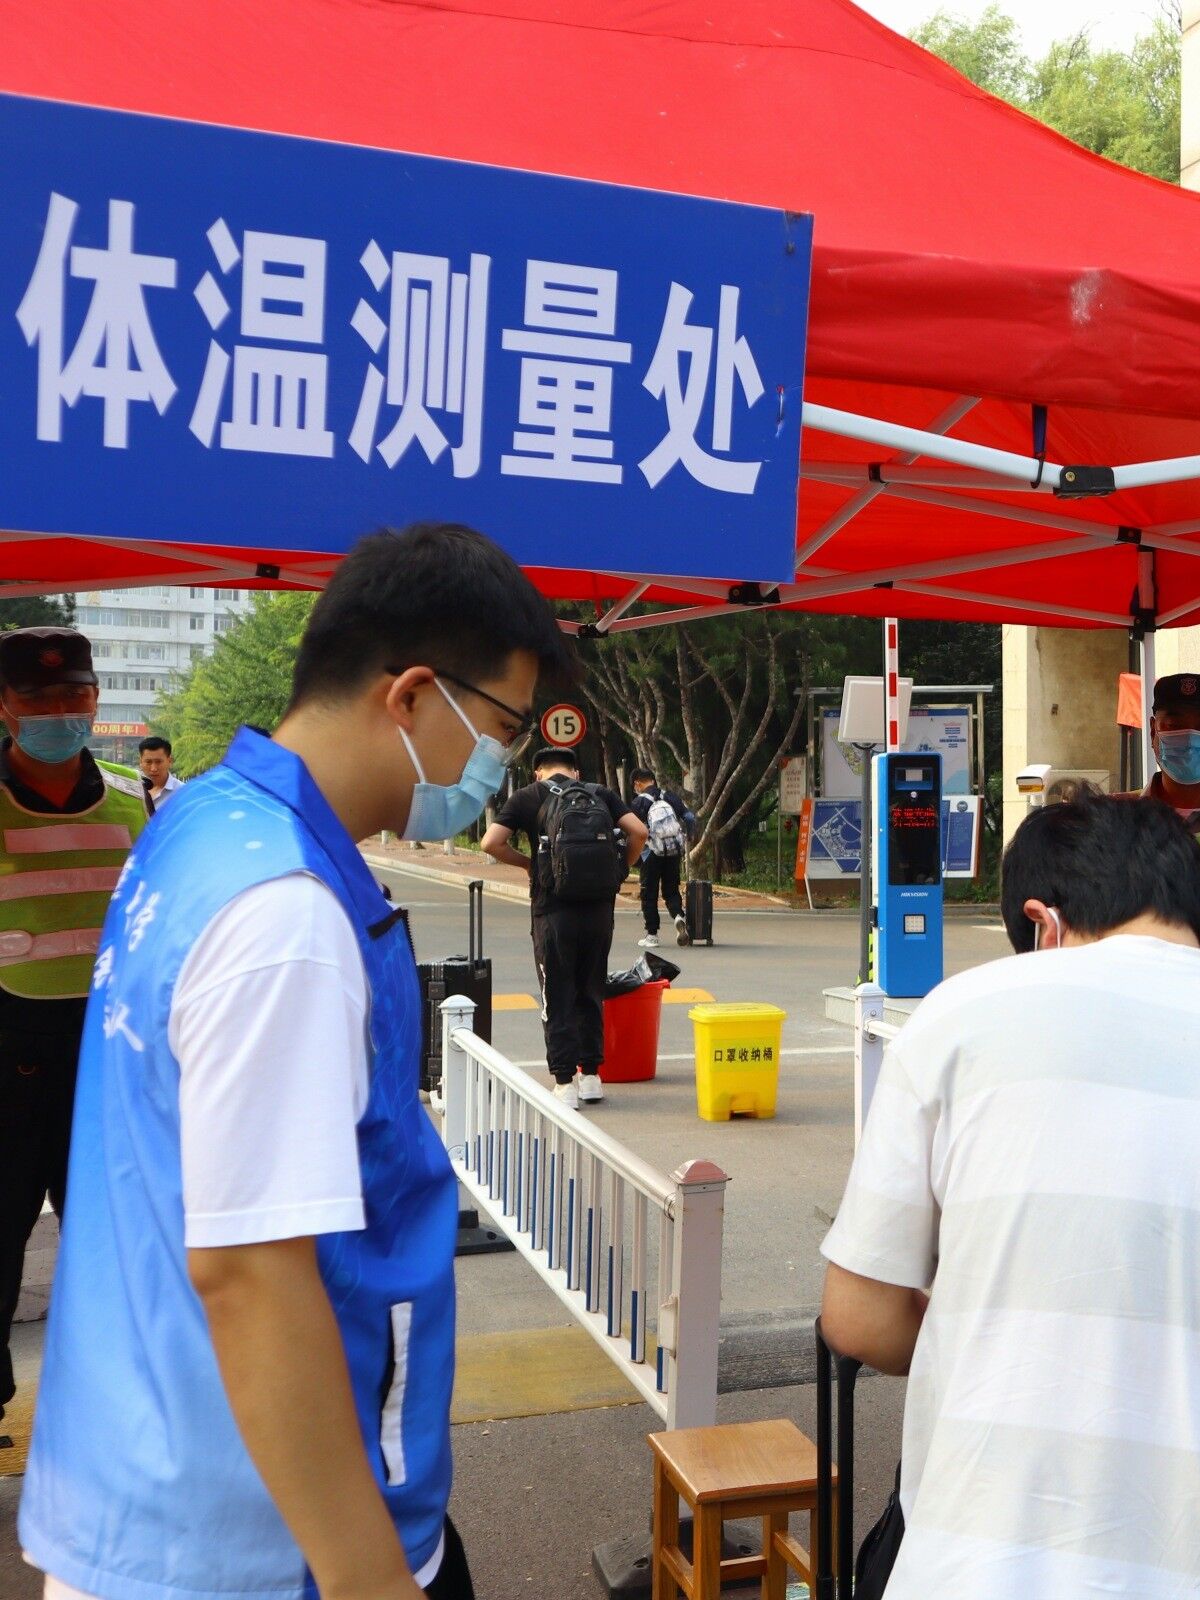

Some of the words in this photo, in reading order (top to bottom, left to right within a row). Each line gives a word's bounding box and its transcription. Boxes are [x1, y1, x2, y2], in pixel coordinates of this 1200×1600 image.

[15, 192, 766, 494] 体温测量处
[553, 716, 575, 735] 15
[714, 1047, 773, 1062] 口罩收纳桶
